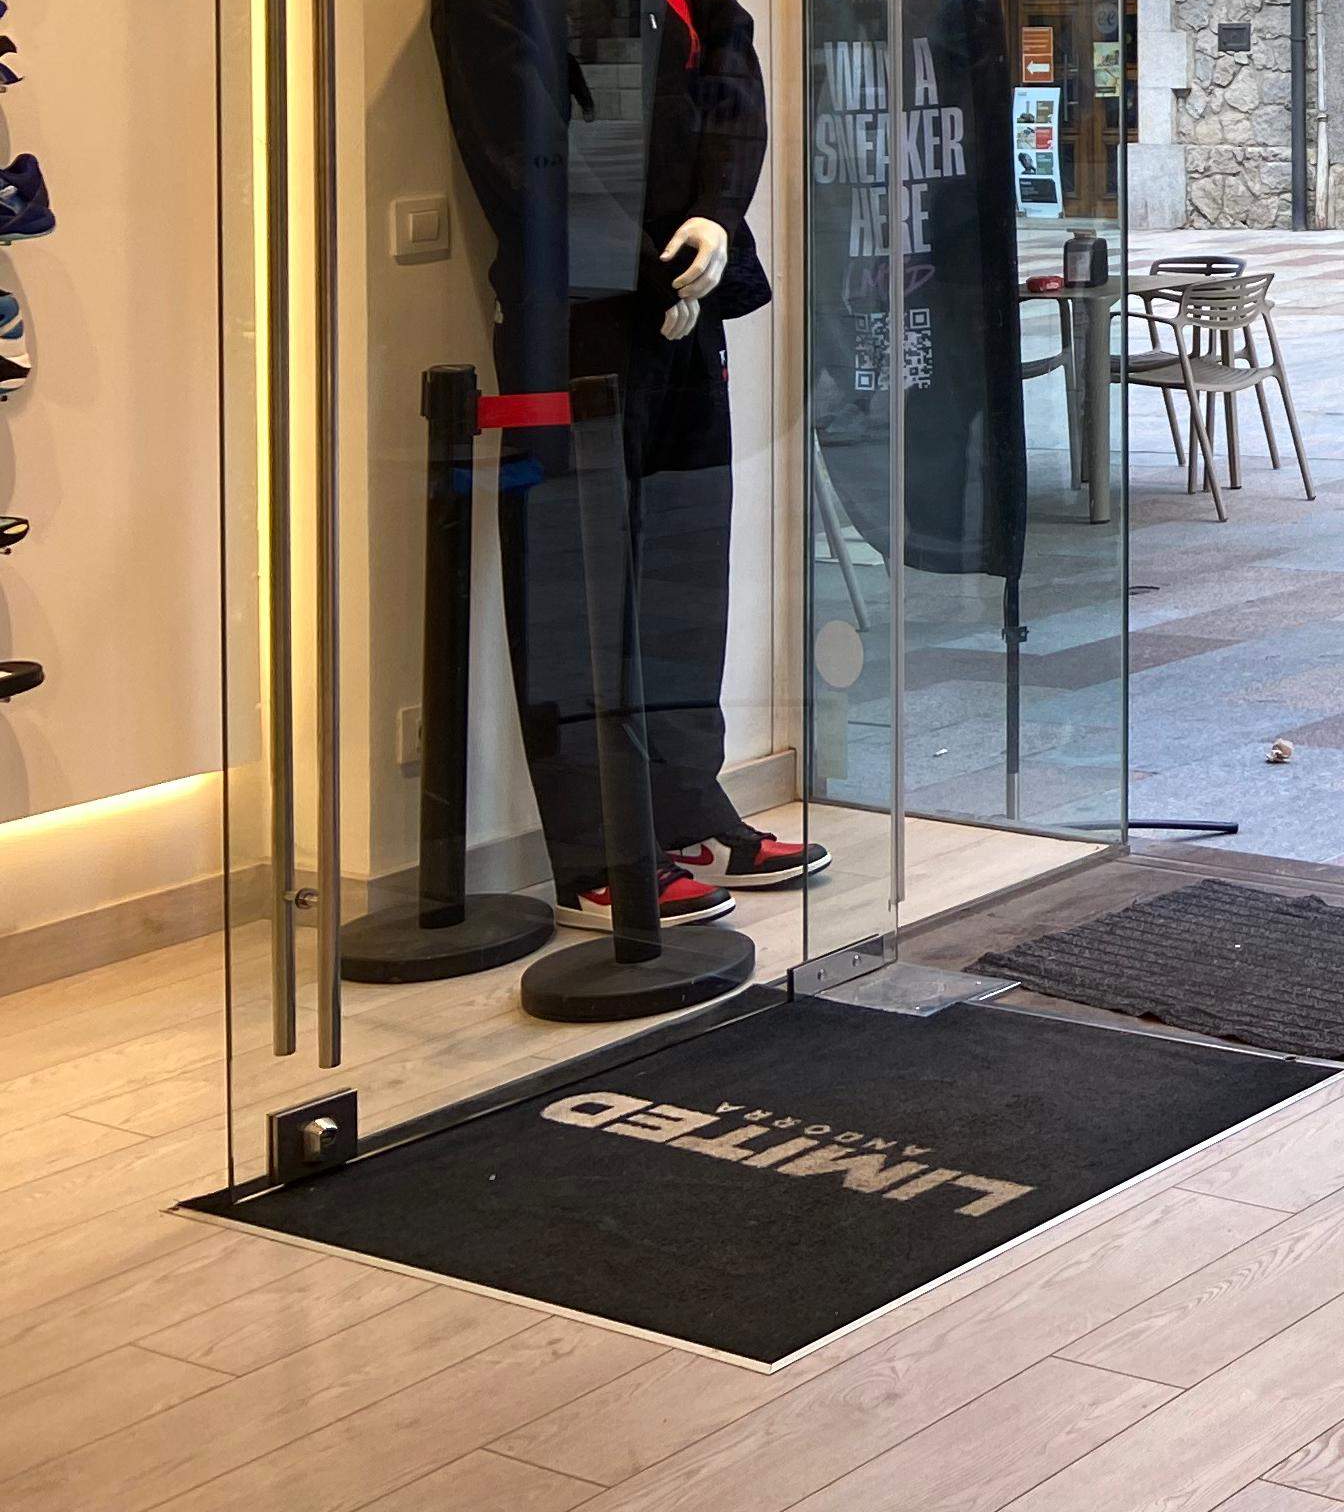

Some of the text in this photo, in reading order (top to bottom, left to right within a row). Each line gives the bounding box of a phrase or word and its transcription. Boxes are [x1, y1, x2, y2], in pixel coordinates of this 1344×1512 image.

[912, 36, 939, 107] A
[813, 105, 967, 185] SNEAKER
[849, 182, 932, 258] HERE
[540, 1091, 1038, 1218] LIMITED
[714, 1101, 933, 1156] ANDORRA
